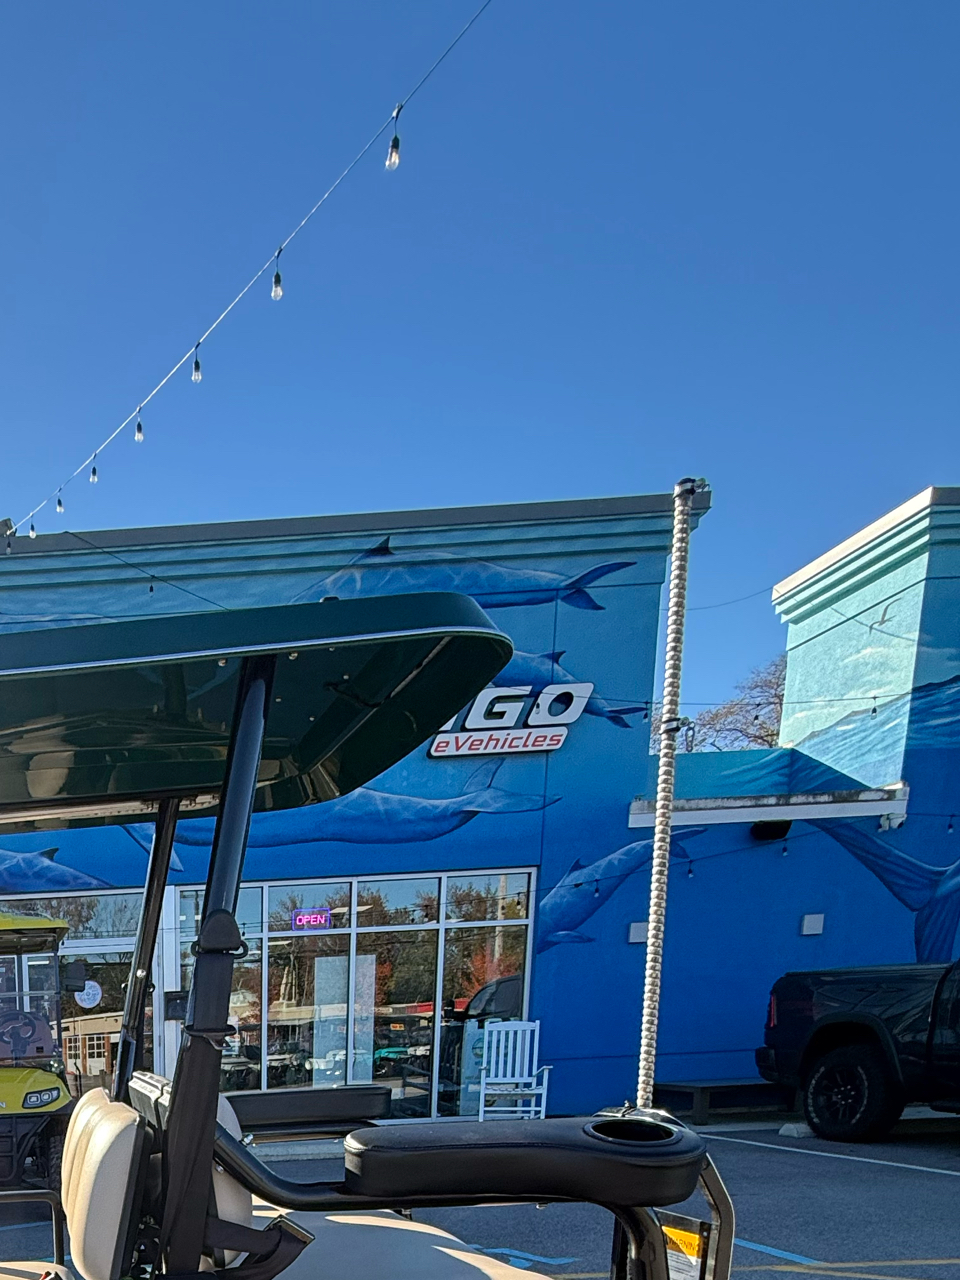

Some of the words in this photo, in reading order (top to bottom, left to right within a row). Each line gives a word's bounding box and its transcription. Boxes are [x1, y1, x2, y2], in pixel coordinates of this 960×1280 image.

[439, 682, 594, 731] GO
[434, 731, 564, 753] eVehicles
[296, 914, 326, 926] OPEN
